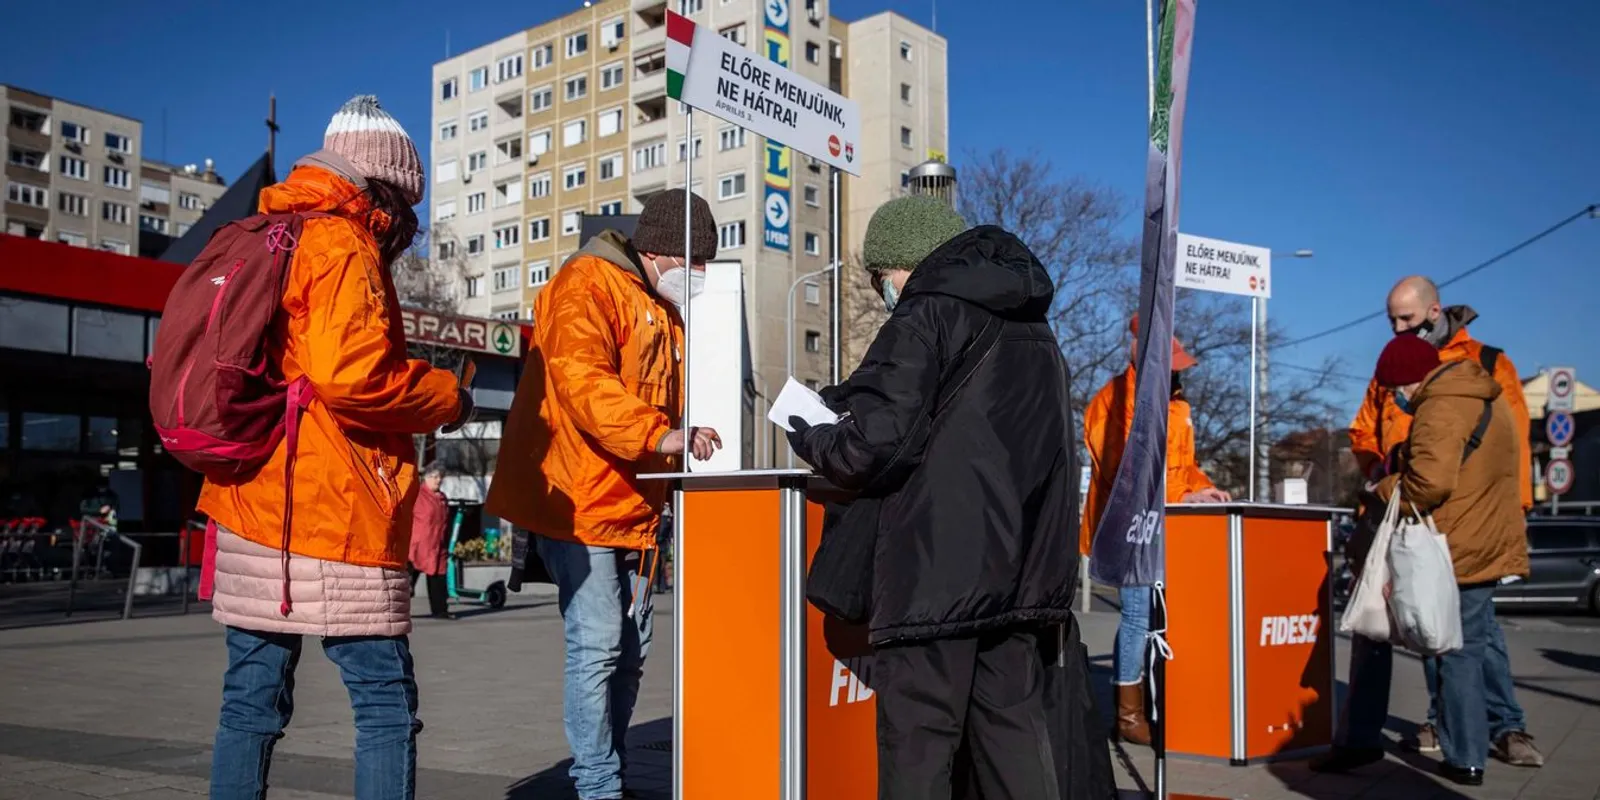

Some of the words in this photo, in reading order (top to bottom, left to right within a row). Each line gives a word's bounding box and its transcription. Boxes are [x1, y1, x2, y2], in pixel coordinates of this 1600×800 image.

[717, 77, 740, 103] NE
[743, 88, 798, 129] HÁTRA!
[721, 51, 771, 91] ELŐRE
[775, 78, 846, 129] MENJÜNK,
[1187, 243, 1215, 261] ELŐRE
[1185, 261, 1198, 275] NE
[1199, 261, 1231, 280] HÁTRA!
[401, 311, 485, 346] SPAR
[1260, 614, 1320, 647] FIDESZ
